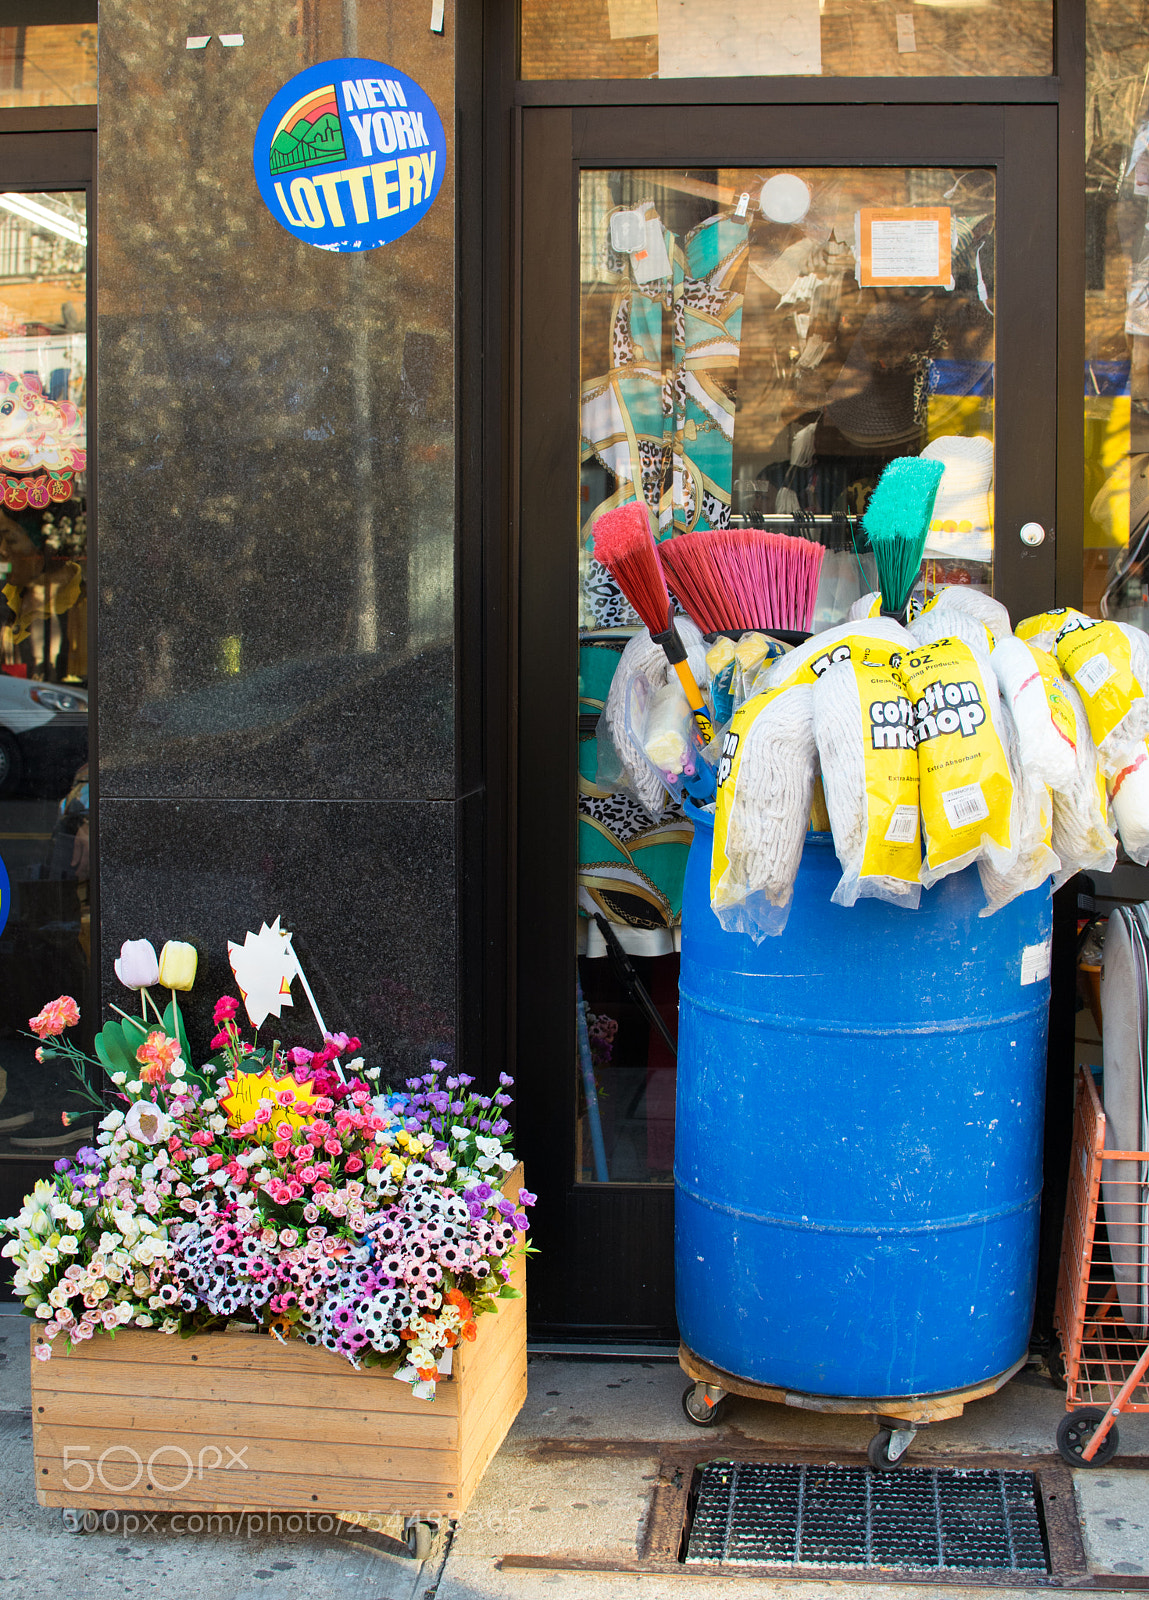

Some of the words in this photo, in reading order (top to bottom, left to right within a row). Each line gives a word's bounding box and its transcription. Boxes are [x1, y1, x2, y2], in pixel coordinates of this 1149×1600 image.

[341, 79, 408, 112] NEW
[348, 111, 430, 158] YORK
[273, 150, 437, 229] LOTTERY
[909, 654, 934, 669] OZ
[925, 660, 960, 672] Products
[926, 763, 945, 773] Extra
